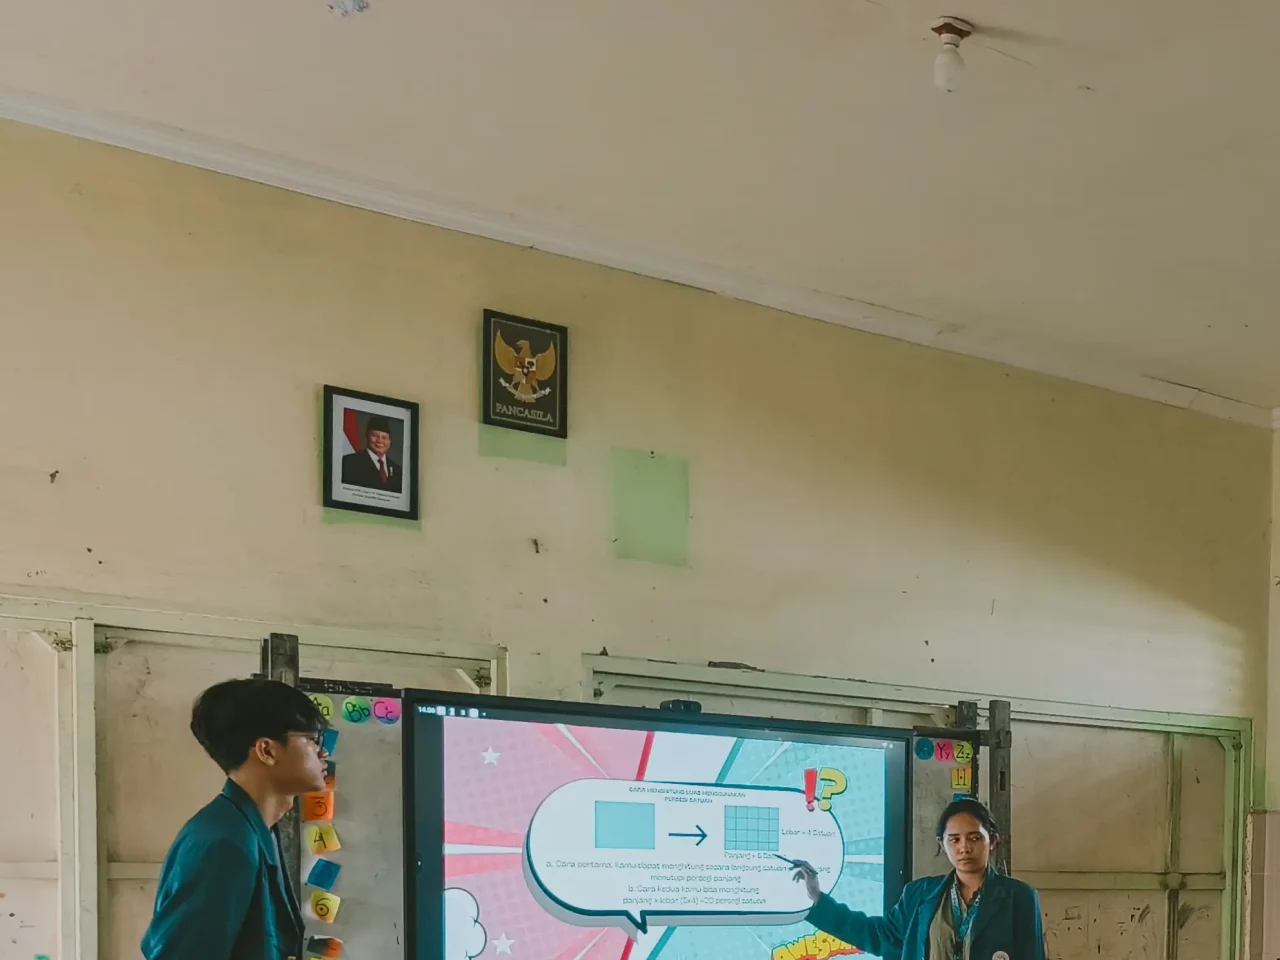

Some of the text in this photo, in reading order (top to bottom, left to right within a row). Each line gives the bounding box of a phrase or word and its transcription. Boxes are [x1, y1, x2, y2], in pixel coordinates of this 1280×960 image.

[496, 402, 553, 422] PANCASILA
[936, 742, 951, 760] Yy
[956, 744, 971, 758] Zz
[313, 830, 327, 849] 4
